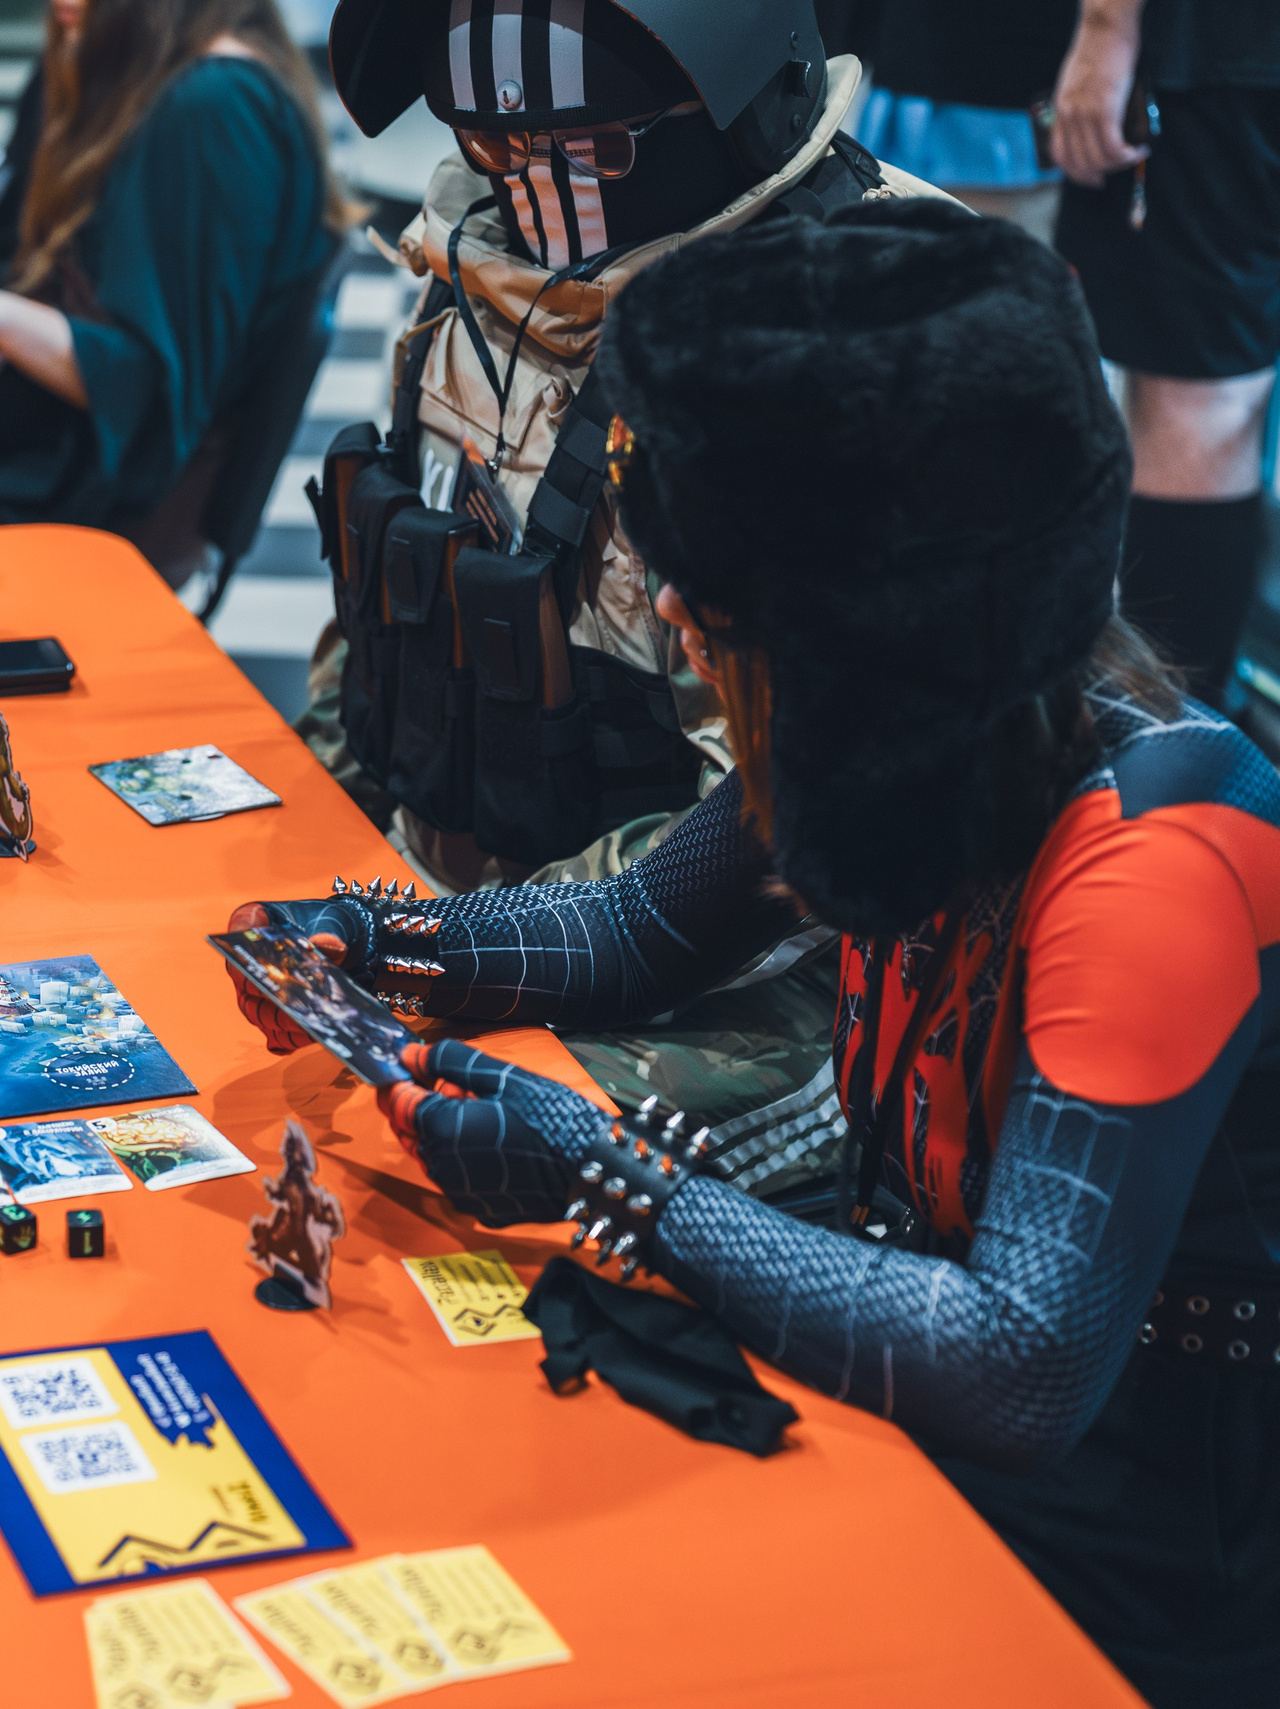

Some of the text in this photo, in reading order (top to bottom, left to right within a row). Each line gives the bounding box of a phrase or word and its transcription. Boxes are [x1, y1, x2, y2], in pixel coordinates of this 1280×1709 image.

[55, 1060, 120, 1074] ТОКИЙСКИЙ
[75, 1067, 108, 1077] ЗАЛИВ
[93, 1121, 106, 1131] 5
